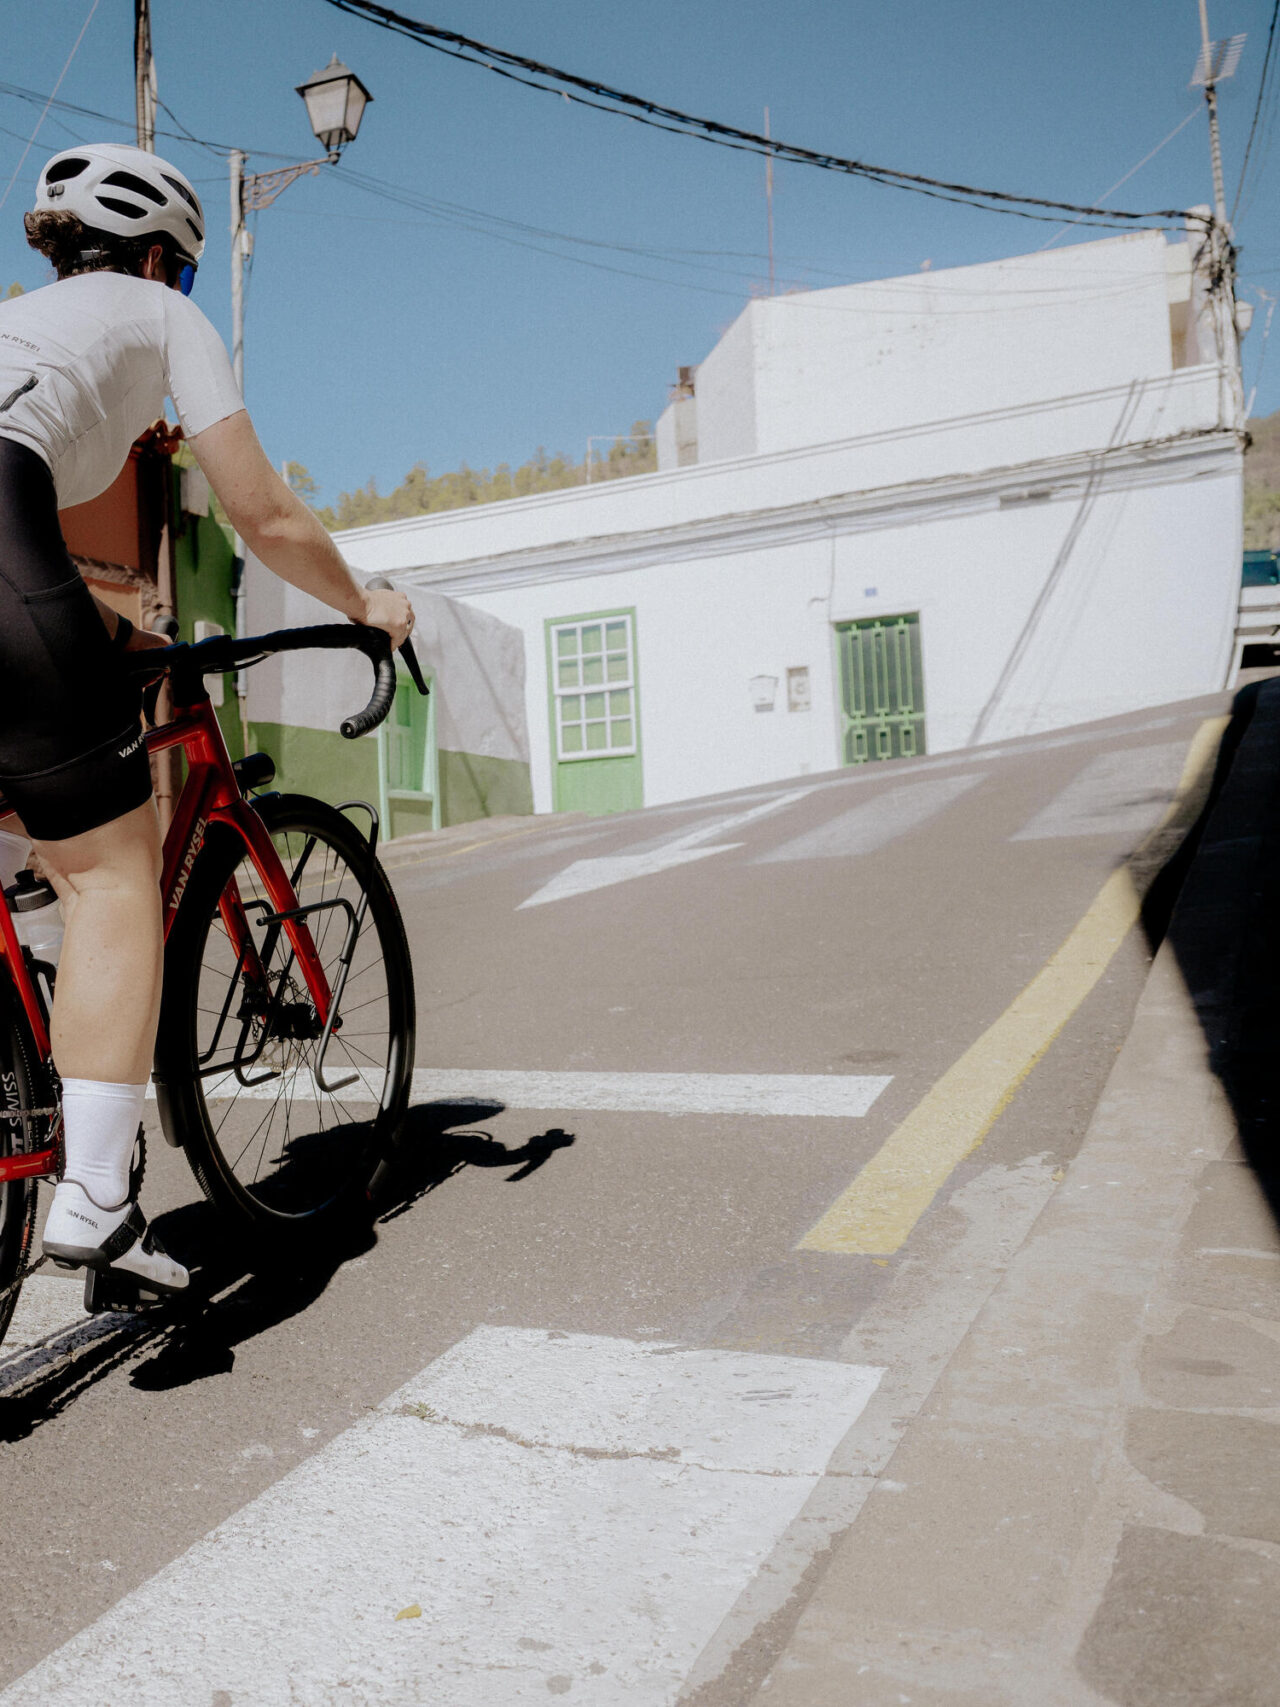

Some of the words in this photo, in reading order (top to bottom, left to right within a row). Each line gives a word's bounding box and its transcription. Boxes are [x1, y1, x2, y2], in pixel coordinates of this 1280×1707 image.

[118, 740, 138, 758] VAN
[169, 869, 189, 911] VAN
[184, 817, 208, 872] RYSEL
[1, 1071, 23, 1127] SWISS
[79, 1214, 99, 1230] RYSEL
